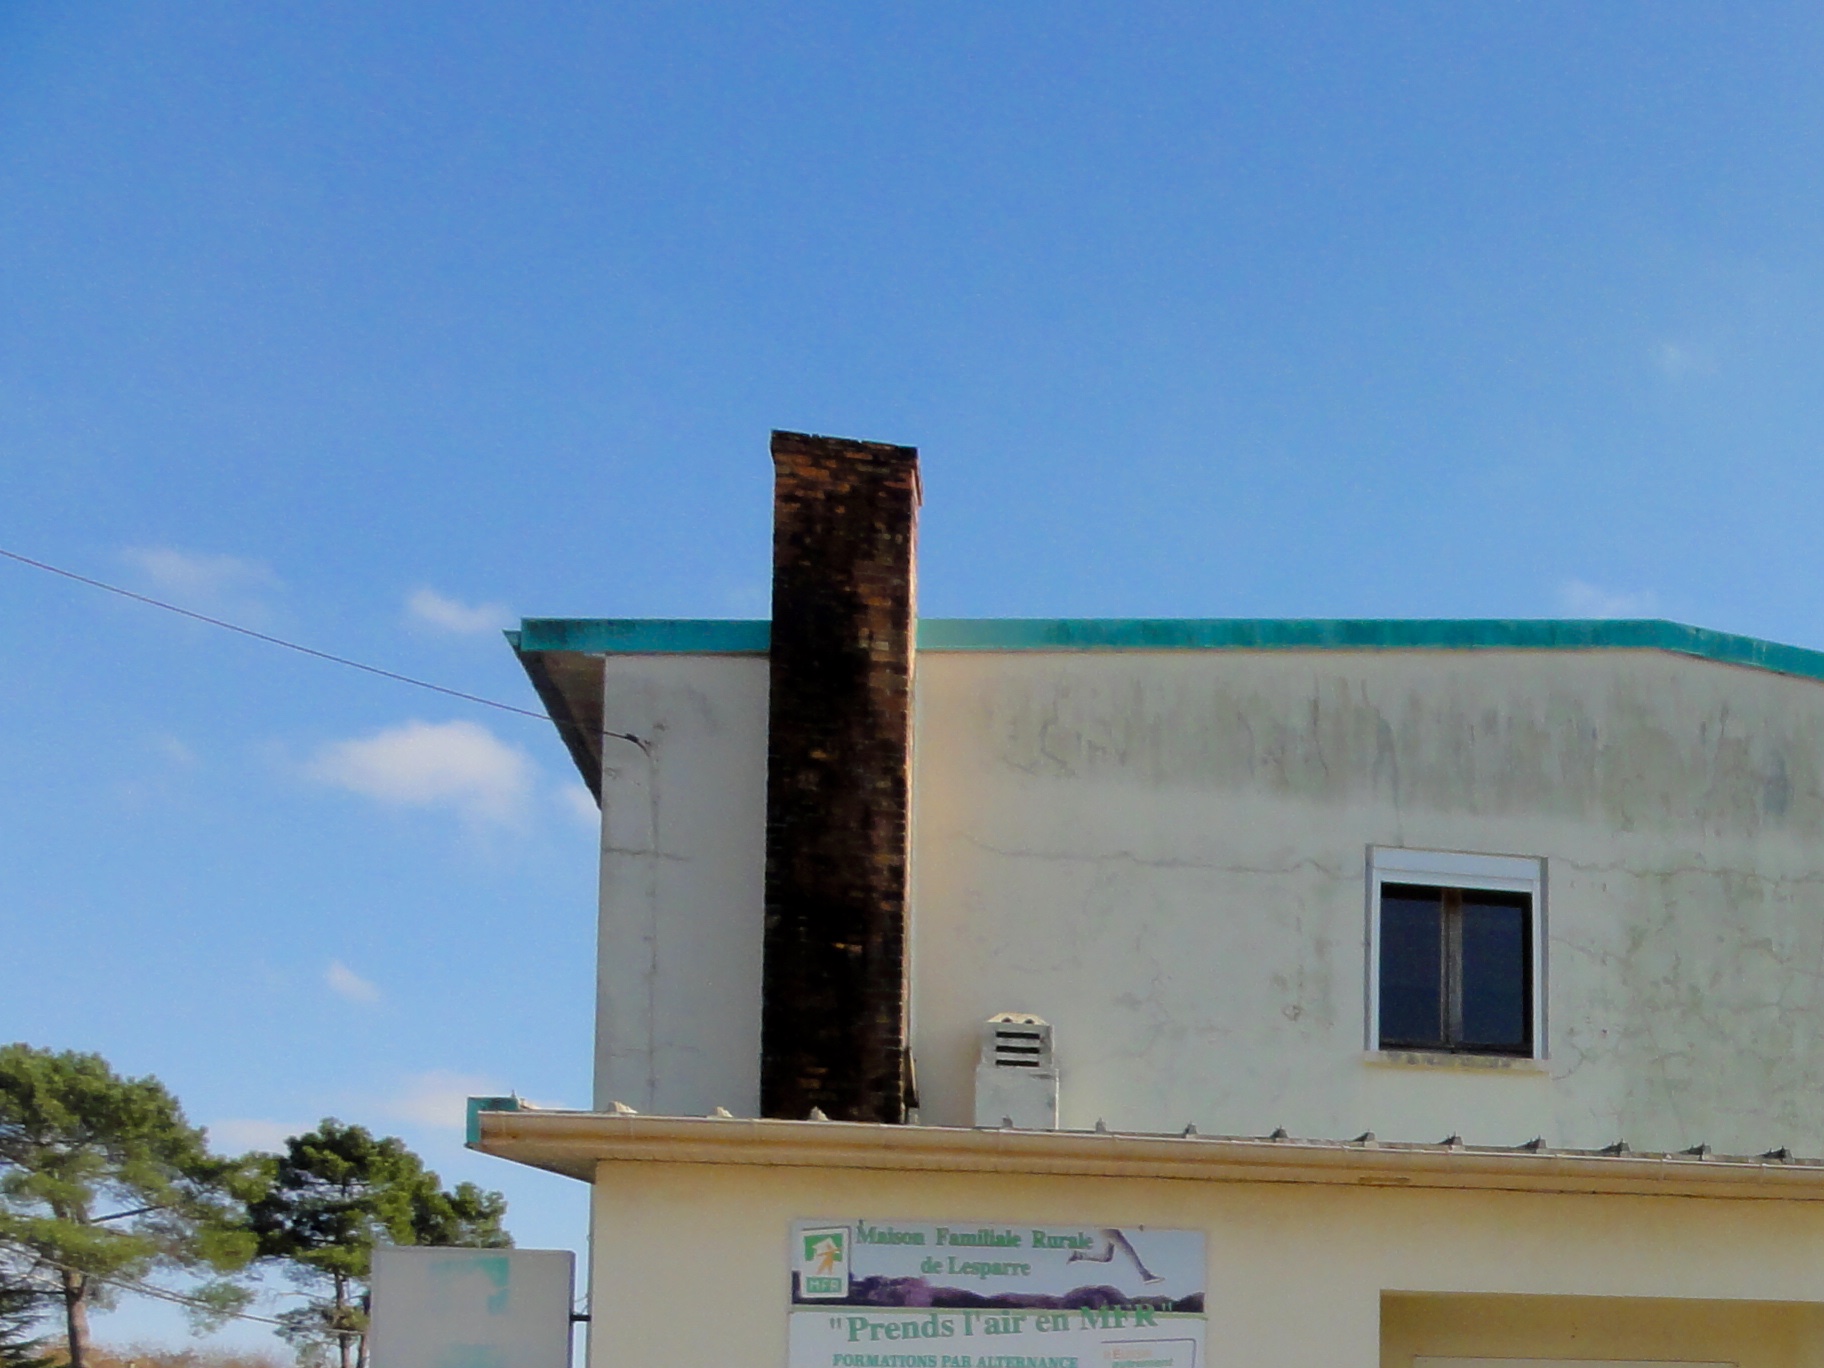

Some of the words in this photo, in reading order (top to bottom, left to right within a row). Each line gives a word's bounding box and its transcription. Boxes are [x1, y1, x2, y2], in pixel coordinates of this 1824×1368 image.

[856, 1225, 926, 1245] Maison
[935, 1227, 1022, 1248] Familiale
[1031, 1229, 1094, 1250] Rurale
[920, 1255, 943, 1274] de
[947, 1256, 1032, 1279] Lesparre
[962, 1309, 1026, 1336] l'air
[1035, 1313, 1070, 1333] en
[832, 1353, 938, 1368] FORMATIONS
[941, 1354, 972, 1368] PAR
